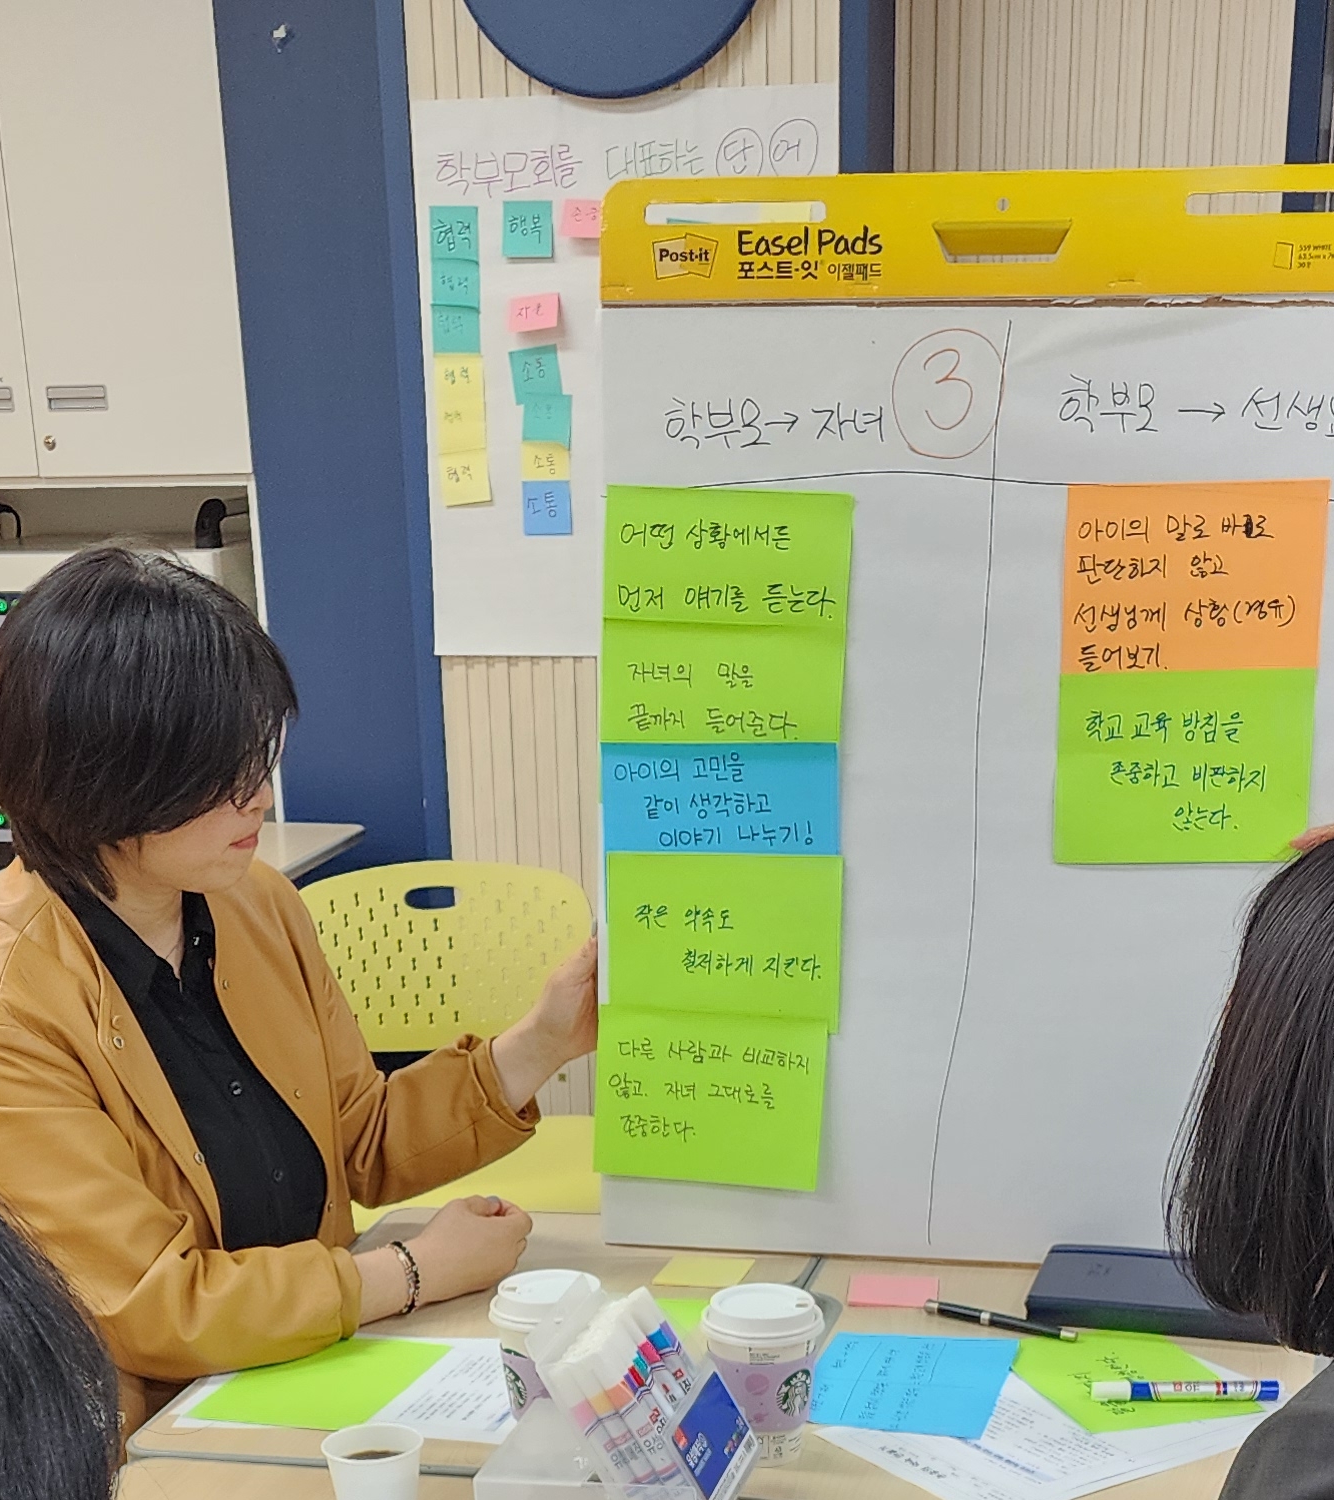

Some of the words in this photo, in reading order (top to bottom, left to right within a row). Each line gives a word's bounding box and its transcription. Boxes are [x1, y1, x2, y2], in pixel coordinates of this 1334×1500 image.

[435, 143, 583, 198] 학부모회를
[605, 139, 705, 180] 대표하는
[432, 218, 472, 252] 협력
[507, 213, 543, 244] 행복
[737, 225, 809, 257] Easel
[817, 224, 883, 256] Pads
[658, 247, 710, 264] Post-it
[737, 260, 818, 280] 포스트-잇
[827, 262, 882, 281] 이젤패드
[1059, 373, 1159, 433] 학부모
[665, 397, 770, 449] 학부모
[811, 404, 885, 444] 자녀
[620, 522, 675, 550] 어떤
[685, 518, 792, 551] 상황에서든
[1077, 515, 1150, 544] 아이의
[1166, 513, 1211, 542] 말로
[1076, 553, 1167, 585] 판단하지
[1189, 550, 1230, 579] 않고
[617, 584, 665, 612] 먼저
[684, 583, 750, 613] 얘기를
[761, 583, 837, 620] 듣는다.
[1073, 601, 1167, 633] 선생님께
[627, 661, 693, 689] 자녀의
[716, 662, 754, 689] 말을
[627, 702, 686, 732] 끝까지
[705, 707, 798, 740] 들어준다.
[1085, 709, 1124, 743] 학교
[1131, 711, 1172, 744] 교육
[1181, 710, 1245, 744] 방침을
[613, 758, 680, 783] 아이의
[692, 751, 745, 783] 고민을
[1109, 759, 1180, 789] 존중하고
[1192, 762, 1267, 793] 비판하지
[643, 793, 680, 820] 같이
[688, 792, 772, 820] 생각하고
[1172, 801, 1239, 833] 않는다.
[658, 826, 722, 848] 이야기
[737, 820, 814, 847] 나누기!
[634, 903, 669, 930] 작은
[684, 904, 734, 934] 약속도
[680, 947, 754, 977] 철저하게
[762, 952, 822, 982] 지킨다.
[617, 1036, 656, 1061] 다른
[667, 1039, 733, 1065] 사람과
[742, 1045, 810, 1076] 비교하지
[664, 1081, 697, 1102] 자녀
[707, 1081, 776, 1110] 그대로를
[619, 1113, 697, 1143] 존중한다.
